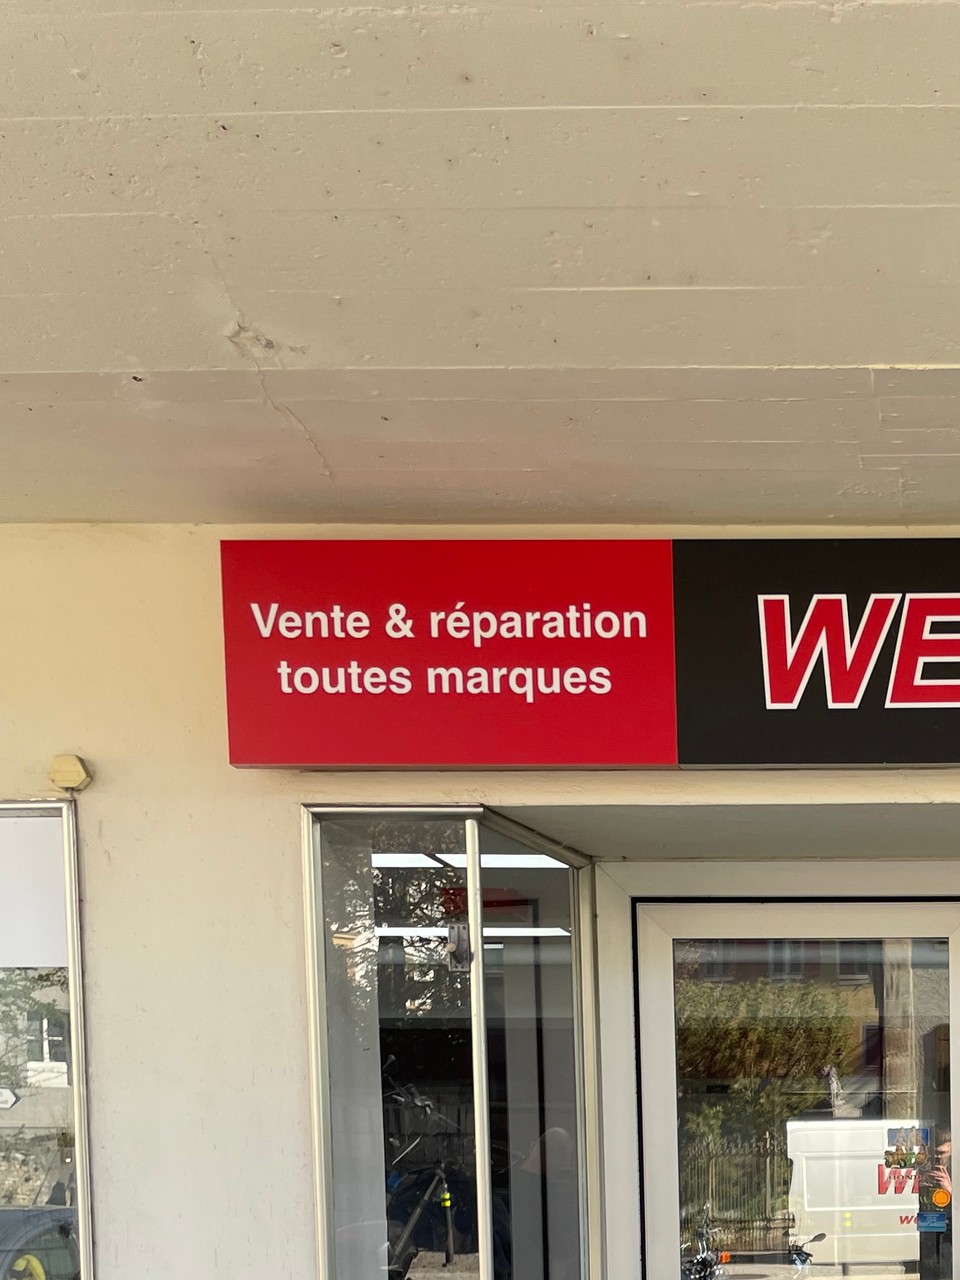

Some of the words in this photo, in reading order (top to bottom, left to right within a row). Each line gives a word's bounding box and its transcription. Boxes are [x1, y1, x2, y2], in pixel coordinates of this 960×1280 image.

[250, 603, 370, 639] Vente
[386, 603, 415, 639] &
[430, 601, 647, 648] réparation
[277, 660, 412, 694] toutes
[427, 666, 612, 703] marques
